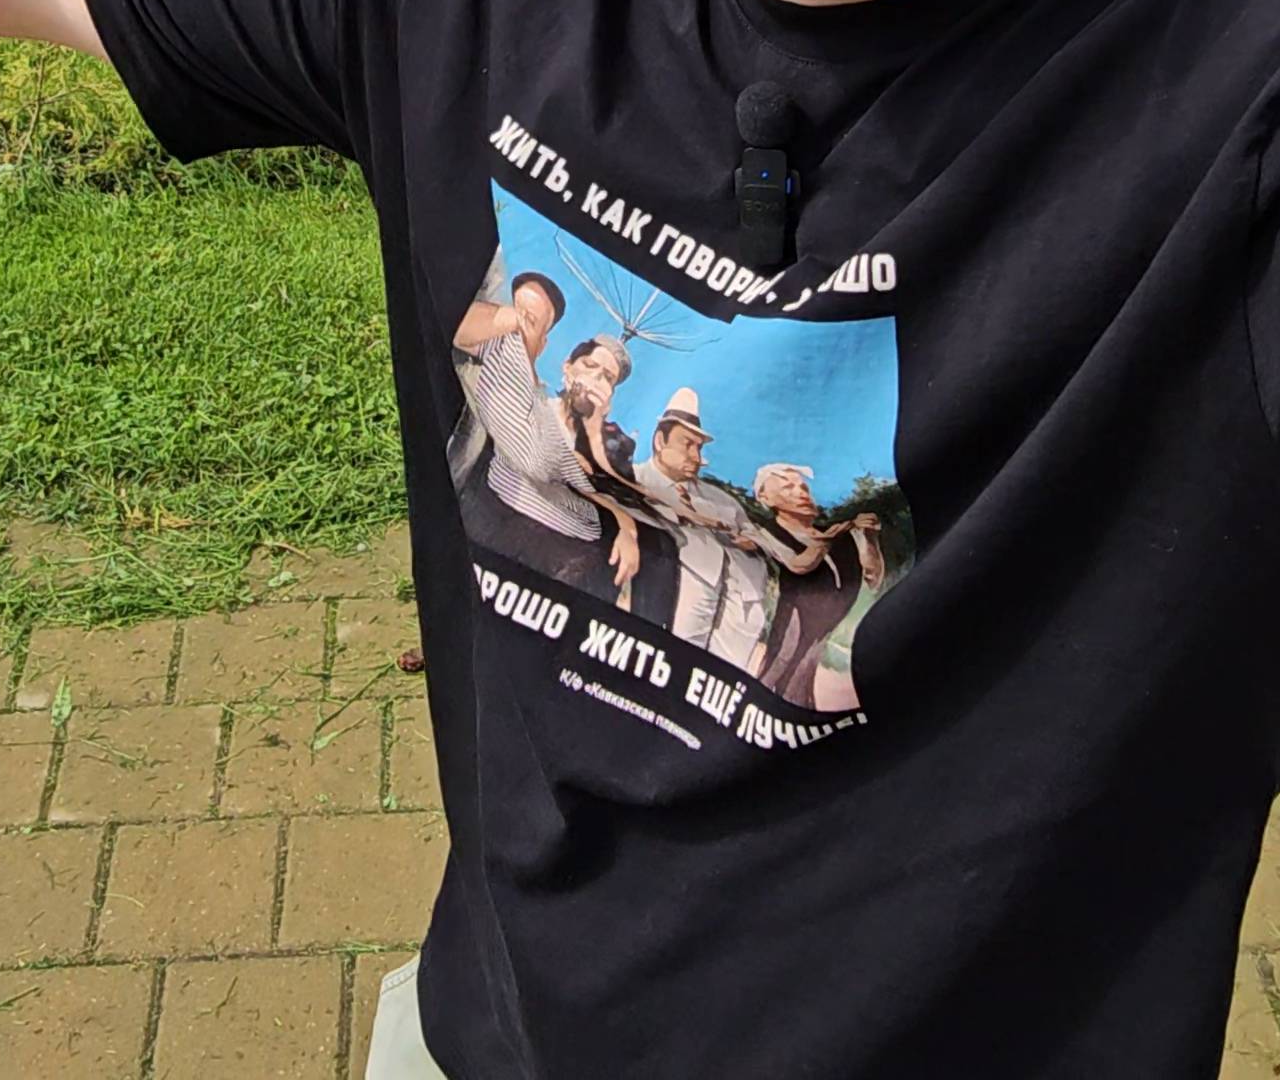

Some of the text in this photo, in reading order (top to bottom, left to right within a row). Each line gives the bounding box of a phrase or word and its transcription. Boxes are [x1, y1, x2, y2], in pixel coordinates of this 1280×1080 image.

[489, 114, 897, 306] ЖИТЬ, КАК ГОВОРИ ШО
[579, 619, 671, 688] ЖИТЬ
[685, 667, 747, 728] ЕЩЁ
